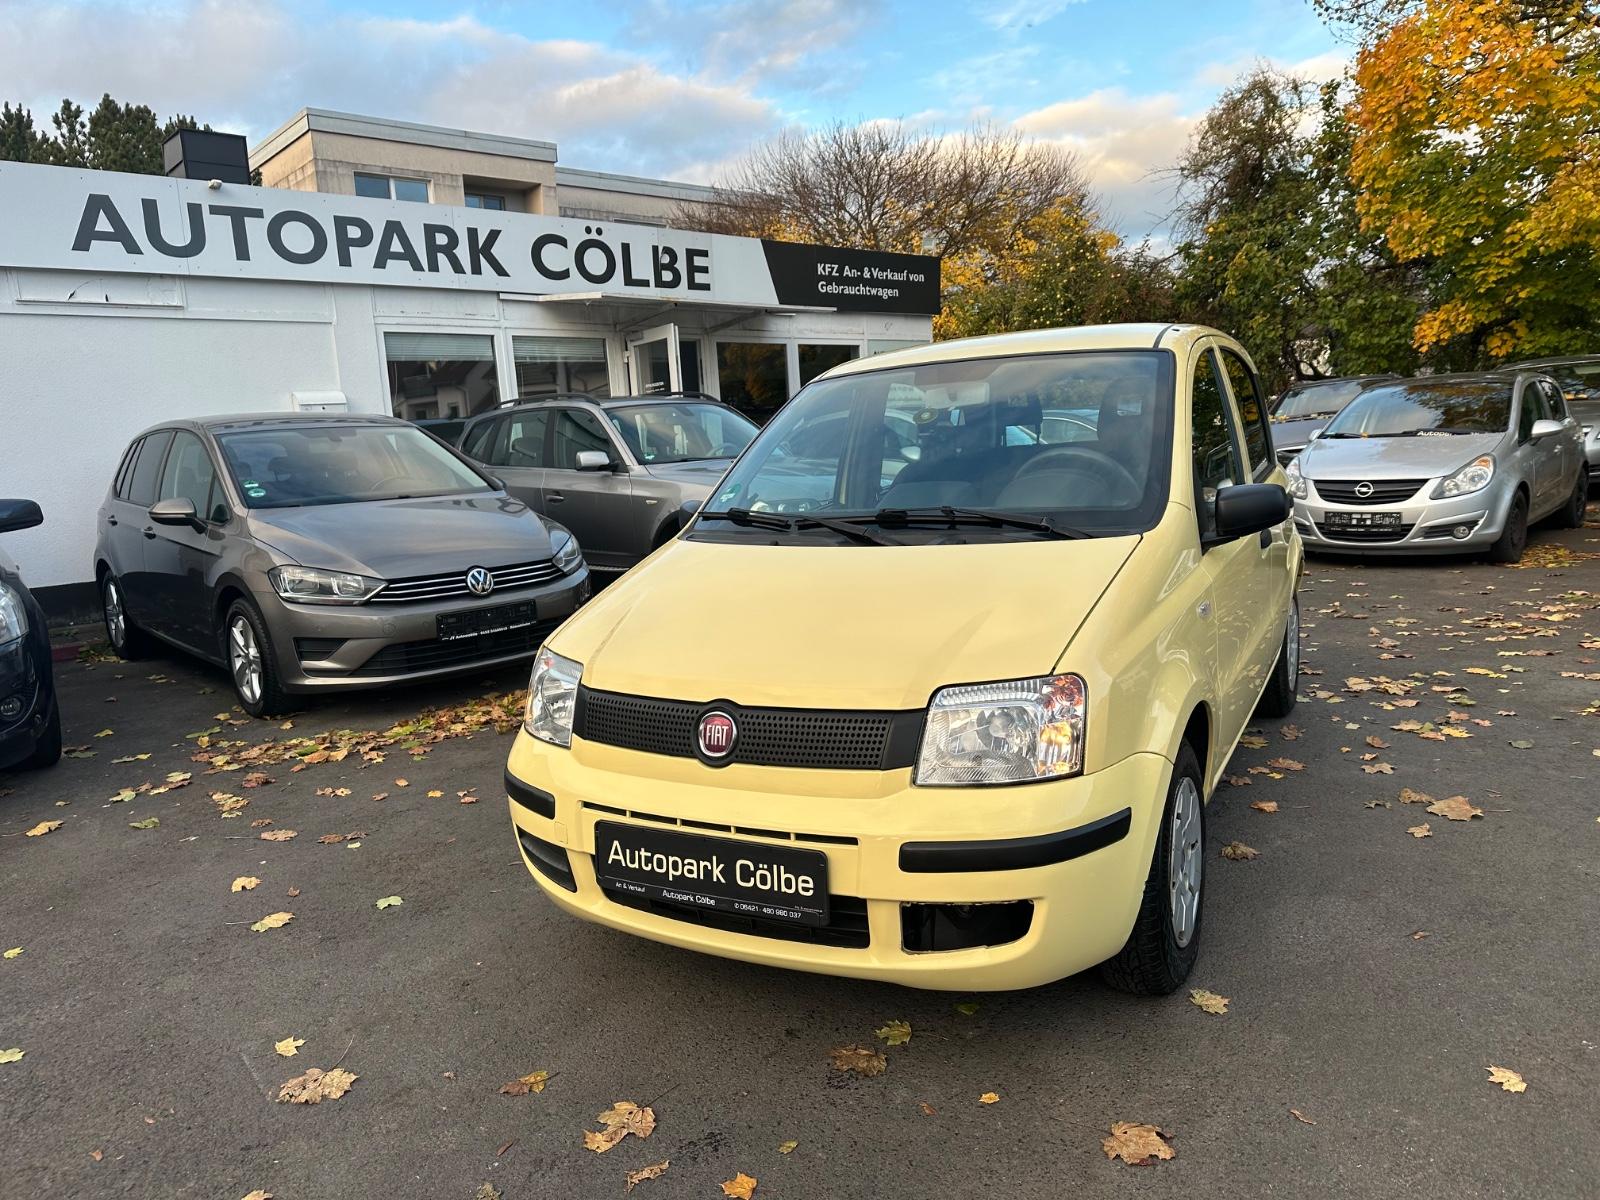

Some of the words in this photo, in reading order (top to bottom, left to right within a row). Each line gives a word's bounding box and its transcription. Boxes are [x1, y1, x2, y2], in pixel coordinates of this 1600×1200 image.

[71, 193, 510, 277] AUTOPARK
[530, 225, 711, 291] CÖLBE
[817, 263, 839, 276] KFZ
[843, 265, 861, 278] An-
[863, 266, 871, 279] &
[871, 267, 908, 281] Verkauf
[908, 272, 925, 282] von
[817, 281, 899, 299] Gebrauchtwagen
[705, 724, 729, 746] FIAT
[607, 840, 726, 883] Autopark
[735, 859, 814, 896] Cölbe
[662, 889, 694, 902] Autopark
[695, 895, 716, 906] Cölbe
